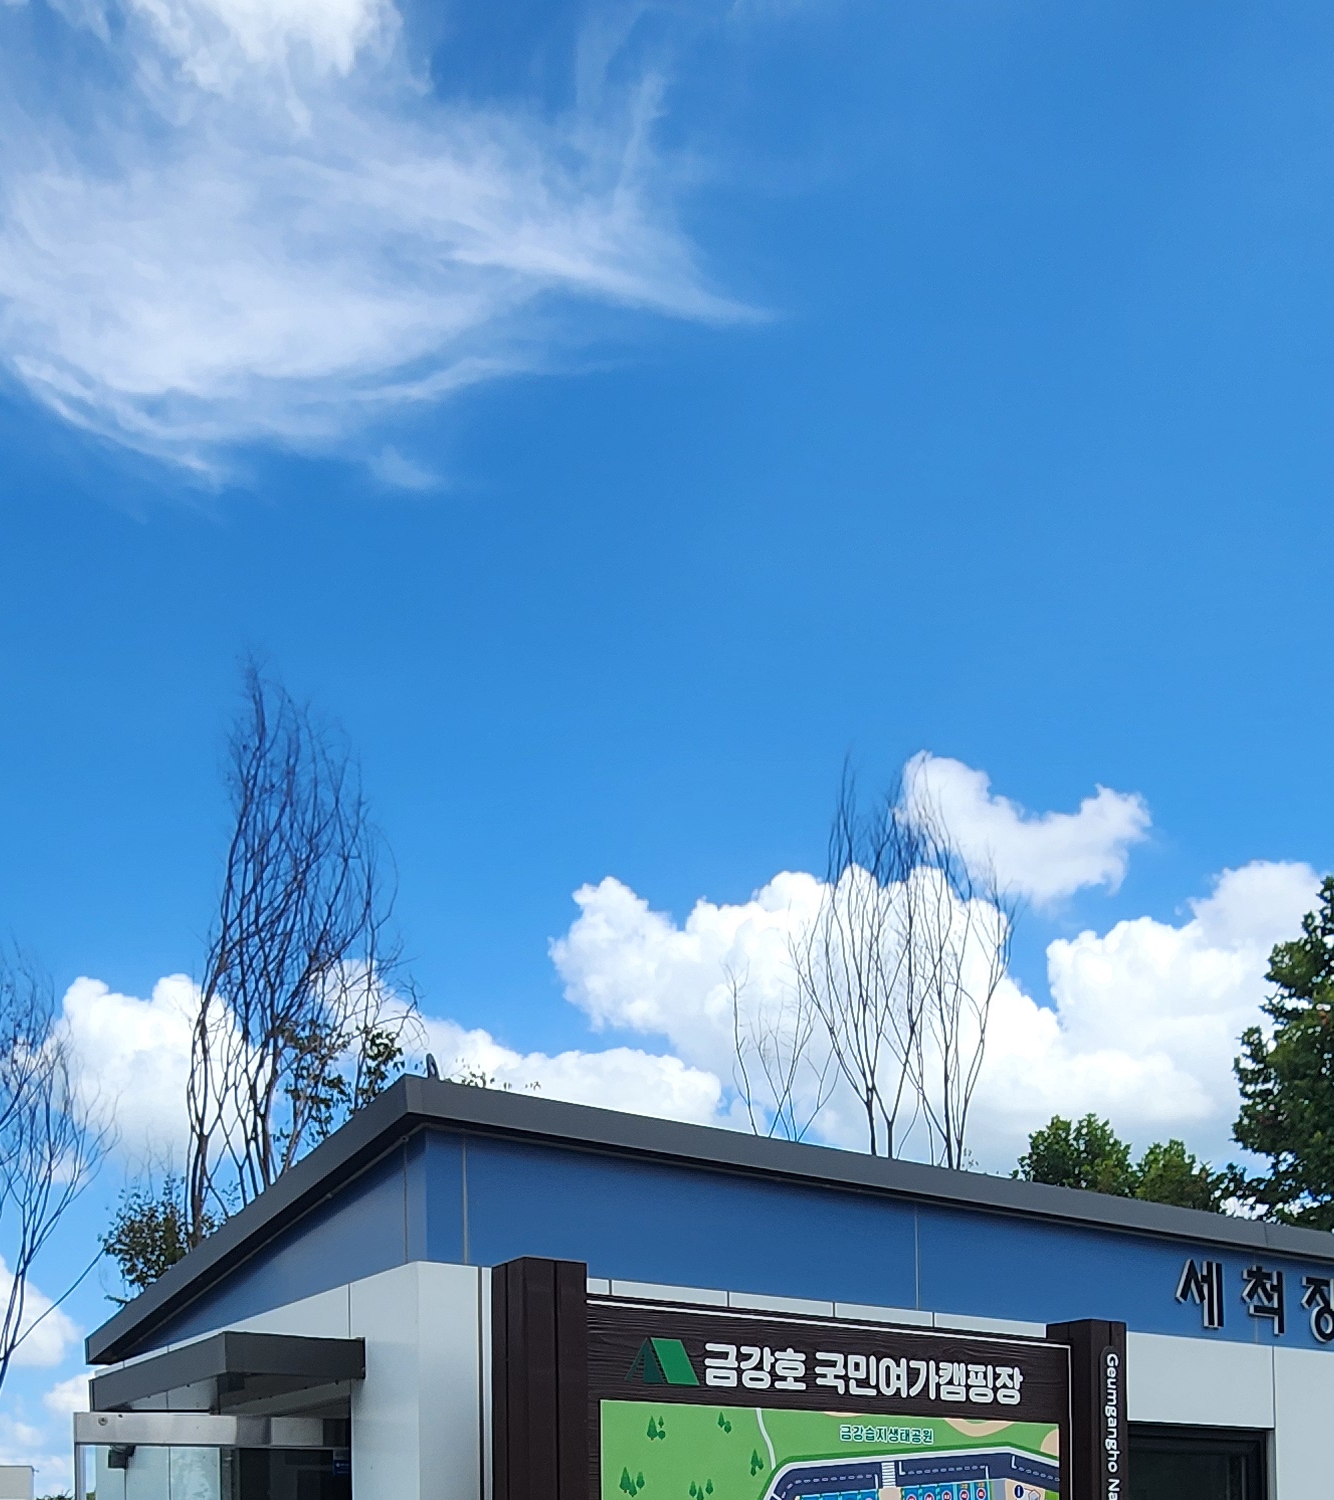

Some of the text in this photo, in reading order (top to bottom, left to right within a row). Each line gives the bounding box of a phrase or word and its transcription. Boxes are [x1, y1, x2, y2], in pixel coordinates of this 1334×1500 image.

[704, 1342, 1024, 1405] 금강호 국민여가캠핑장
[840, 1424, 934, 1445] 금강습지생태공원
[1105, 1353, 1120, 1473] Geumgangho
